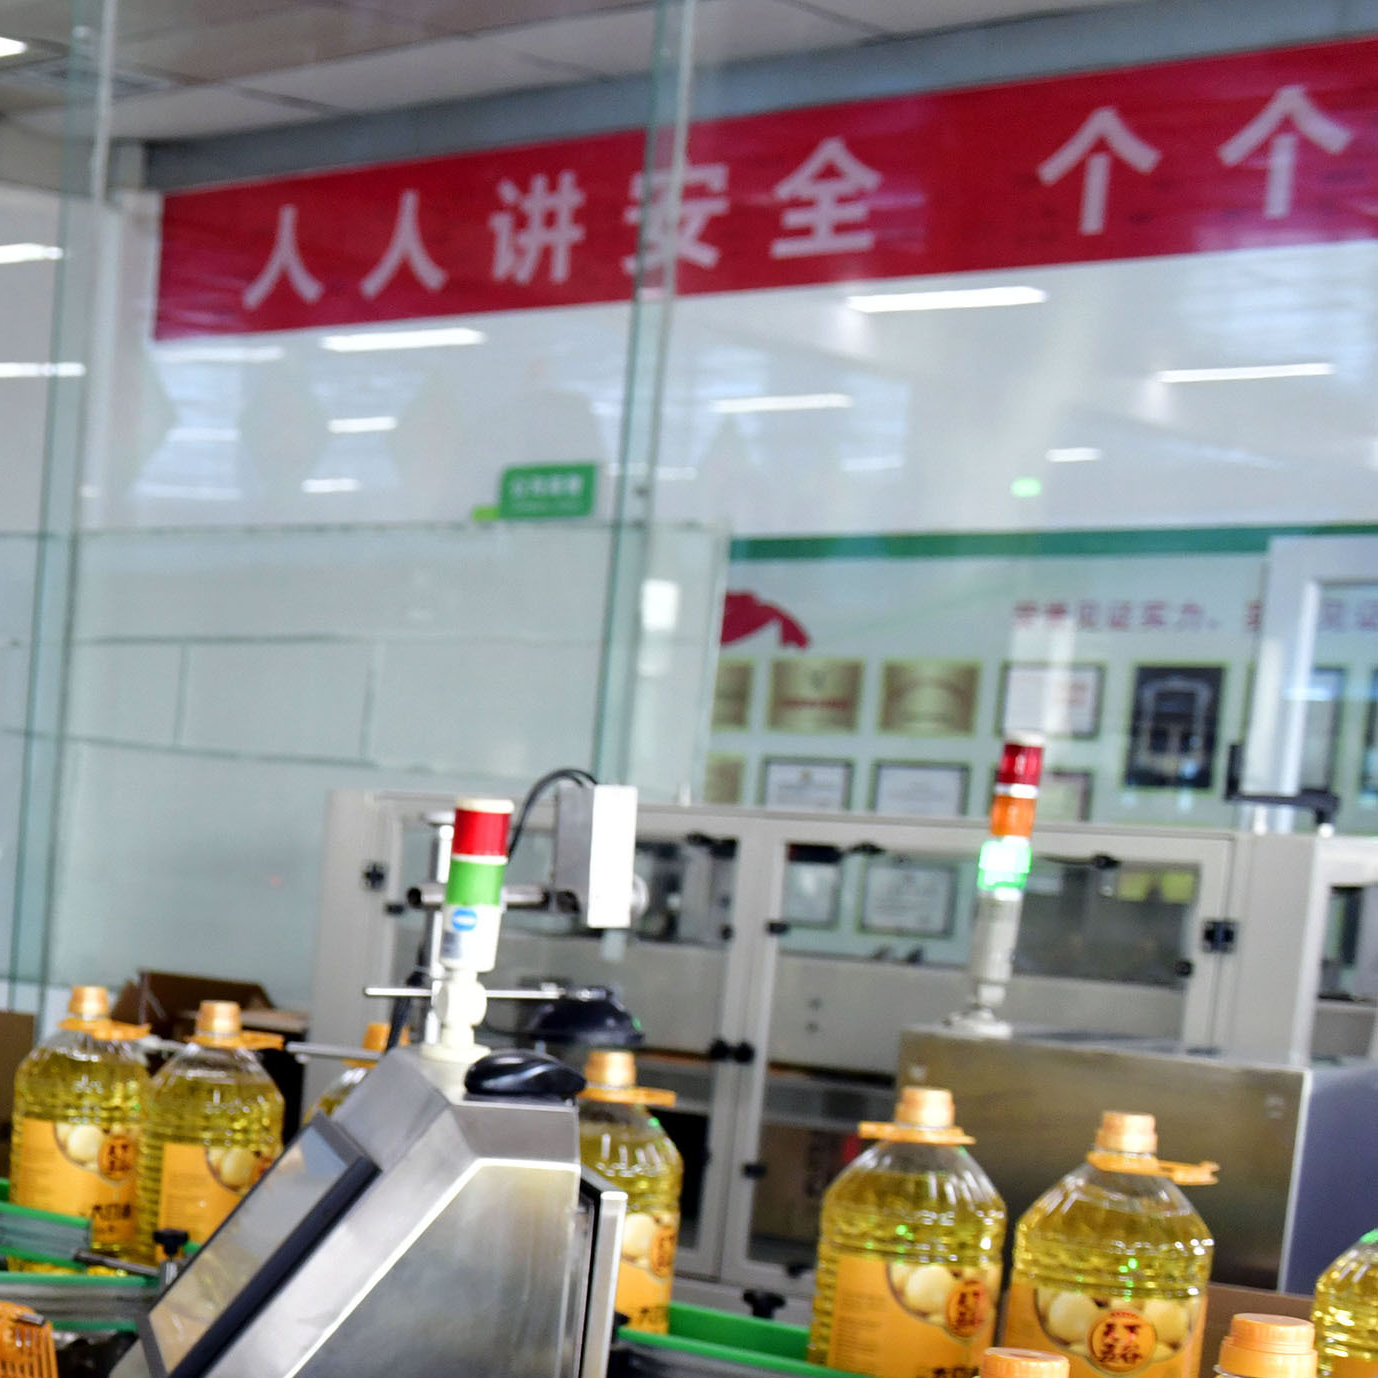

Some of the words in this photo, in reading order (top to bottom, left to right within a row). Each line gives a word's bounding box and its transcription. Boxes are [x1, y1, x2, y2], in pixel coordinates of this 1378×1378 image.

[243, 137, 887, 312] 人人讲安全
[1038, 86, 1352, 236] 个个
